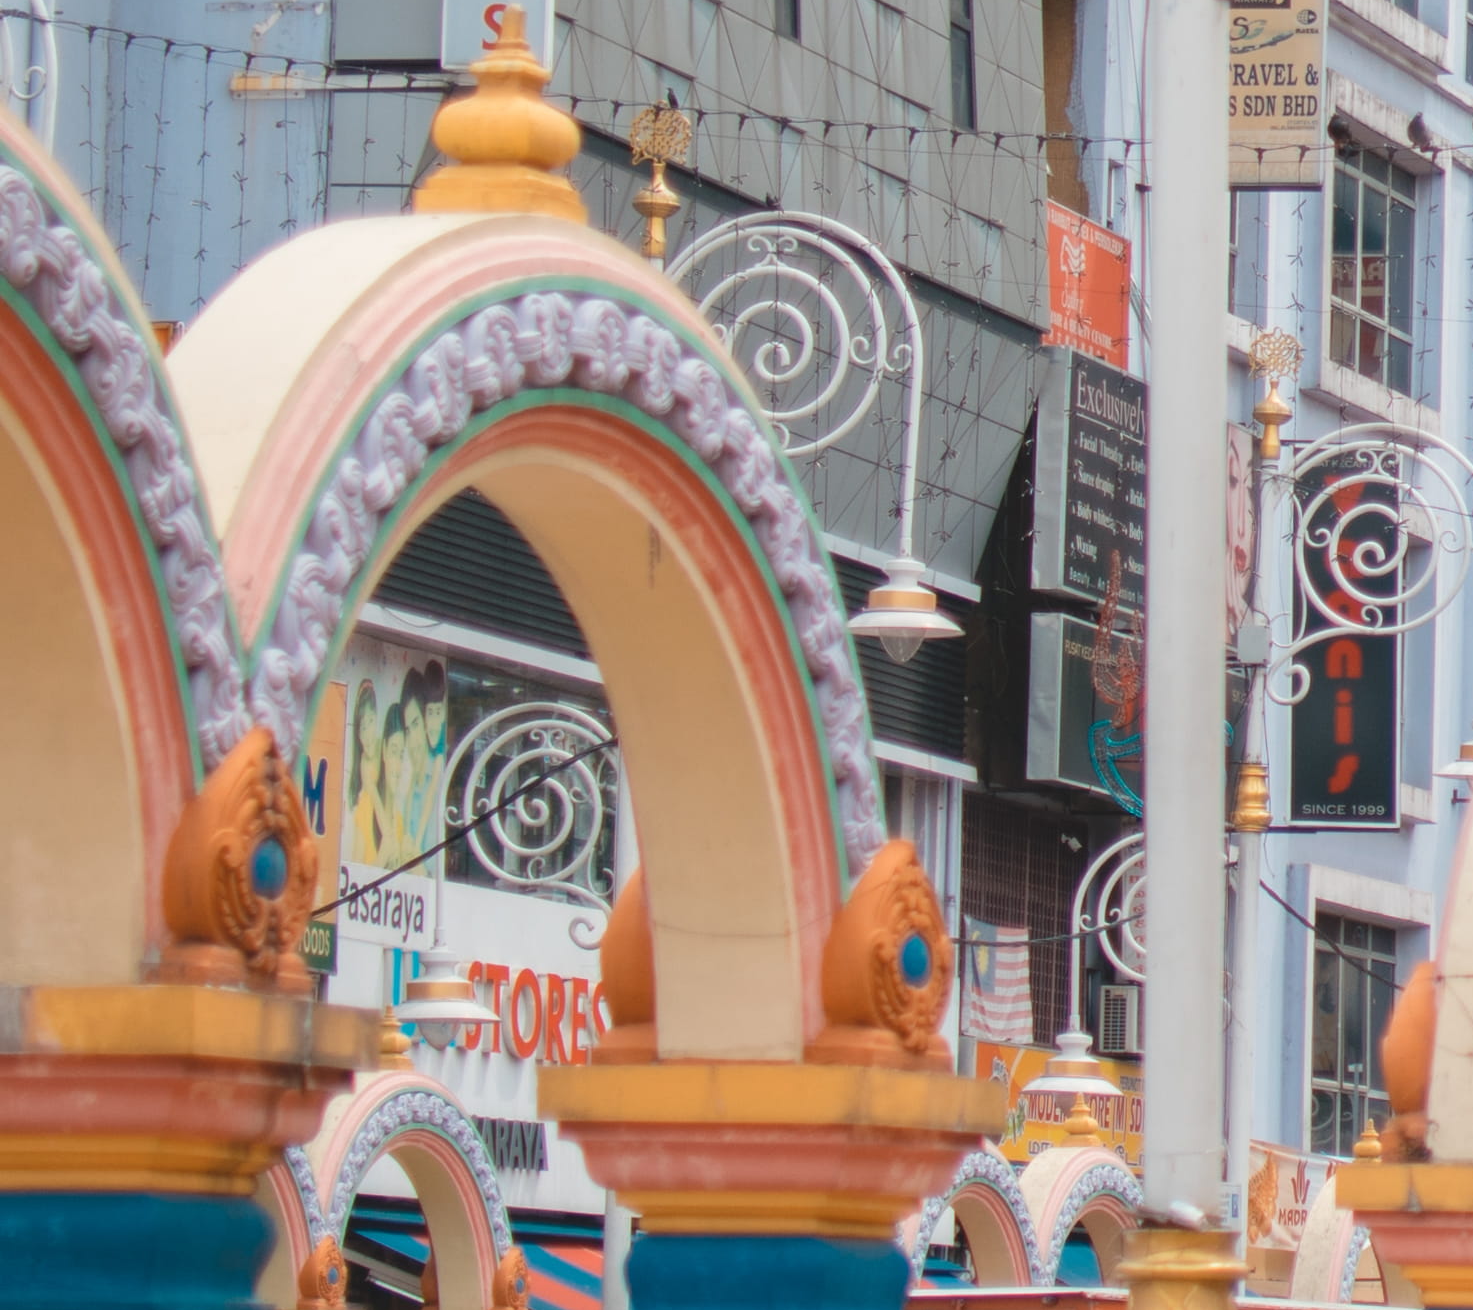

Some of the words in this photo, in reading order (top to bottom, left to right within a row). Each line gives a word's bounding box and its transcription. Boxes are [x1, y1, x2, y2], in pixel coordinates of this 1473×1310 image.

[1231, 63, 1298, 87] RAVEL
[1305, 63, 1319, 87] &
[1243, 94, 1277, 117] SDN
[1282, 94, 1319, 117] BHD
[1076, 369, 1146, 436] Exclusively
[1302, 803, 1347, 816] SINCE
[1351, 804, 1385, 817] 1999
[473, 1113, 548, 1172] ARAYA
